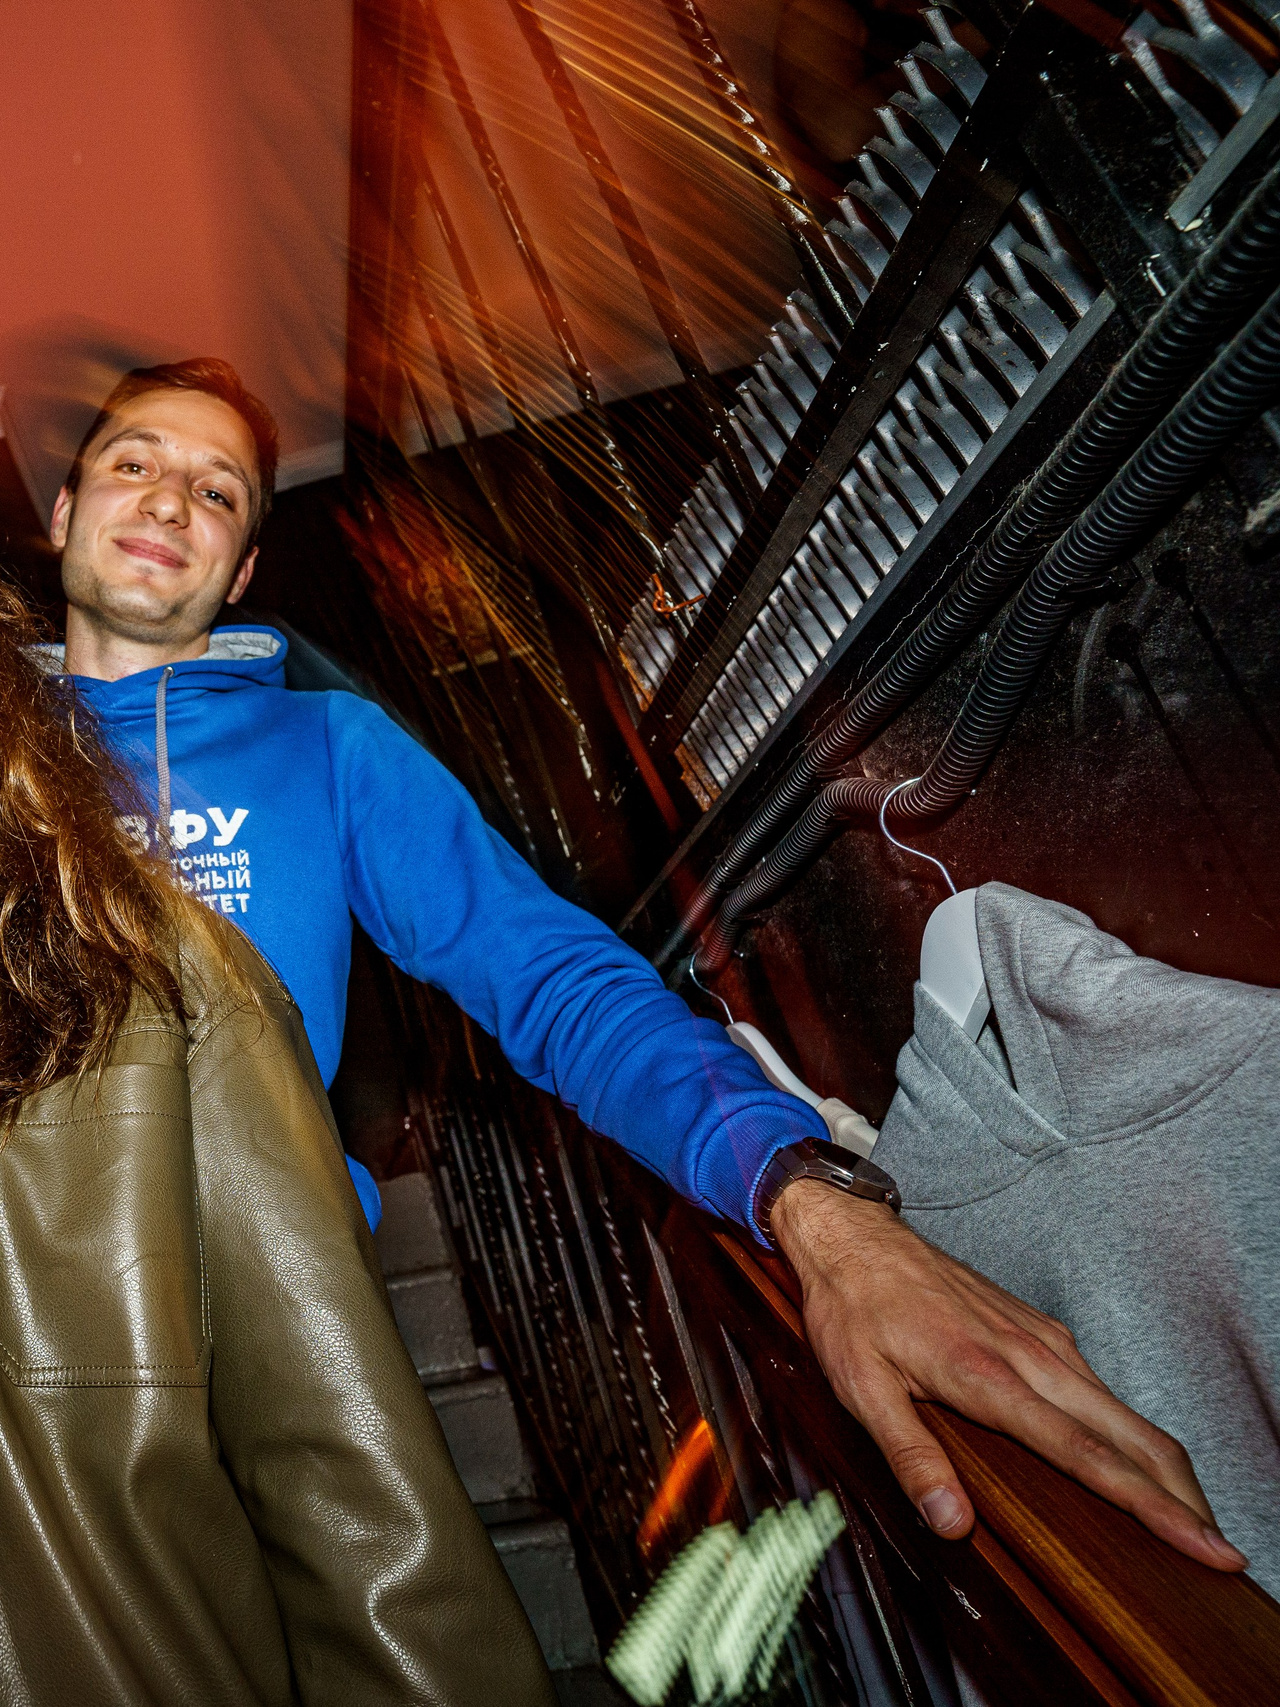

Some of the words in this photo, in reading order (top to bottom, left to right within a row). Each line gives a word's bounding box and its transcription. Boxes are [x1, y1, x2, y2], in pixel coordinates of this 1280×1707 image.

[172, 849, 251, 871] ОЧНЫЙ
[175, 866, 251, 893] ЬНЫЙ
[198, 893, 250, 914] ТЕТ
